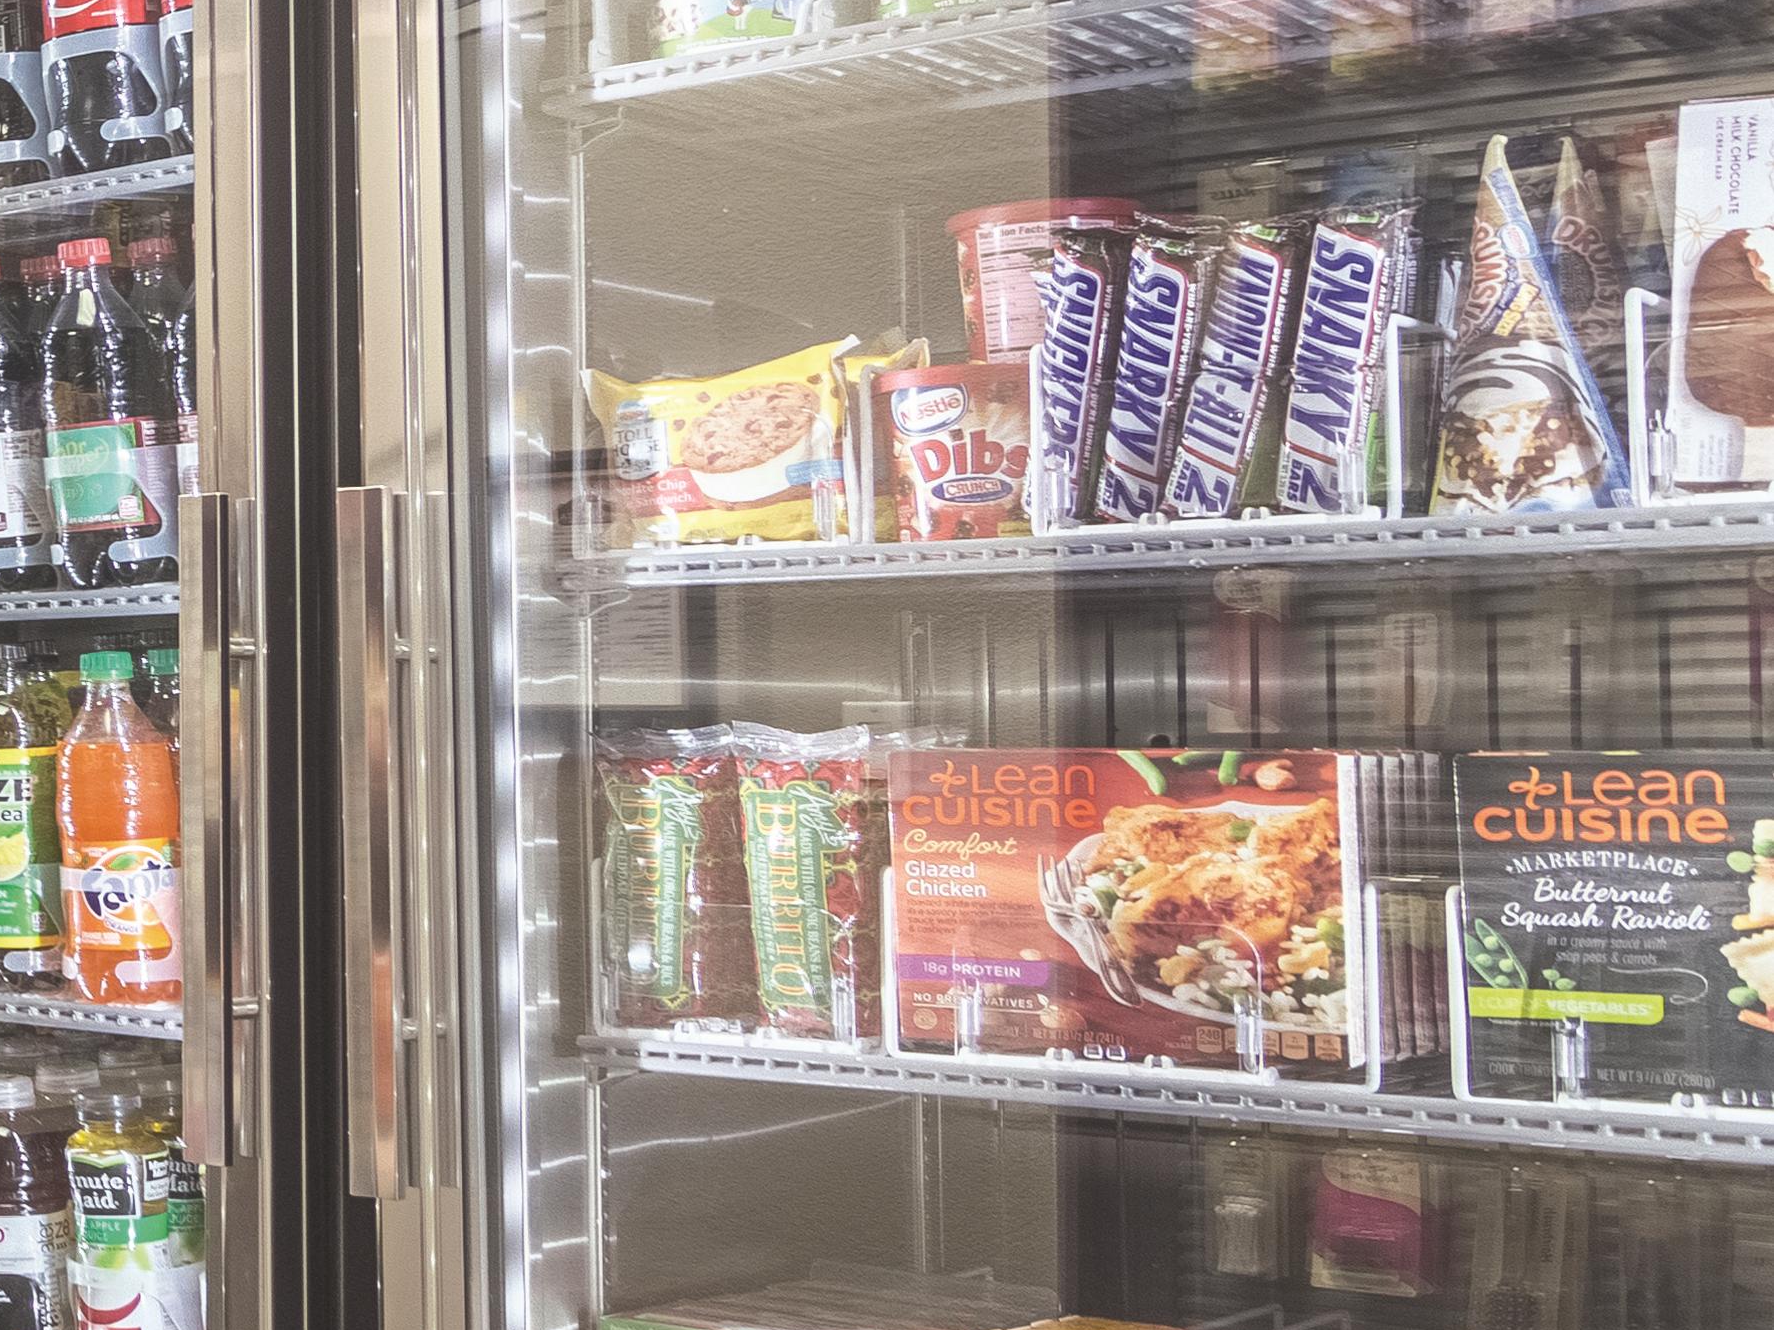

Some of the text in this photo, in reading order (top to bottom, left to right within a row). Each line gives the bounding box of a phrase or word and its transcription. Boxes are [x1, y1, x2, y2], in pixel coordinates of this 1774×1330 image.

[1747, 115, 1757, 161] VANILLA
[1729, 116, 1741, 215] MILK CHOCOLATE
[943, 481, 1000, 496] CRUNCH
[901, 795, 1098, 829] cuisine
[1473, 807, 1730, 843] cuisine
[904, 830, 1017, 858] Comfort
[905, 861, 976, 880] Glazed
[1512, 849, 1689, 877] MARKETPLACE
[905, 879, 988, 898] Chicken
[1534, 876, 1672, 906] Butternut
[1501, 904, 1711, 932] Squash Ravioli
[923, 961, 1021, 978] 18g PROTEIN
[1546, 1000, 1651, 1017] VEGETABLES
